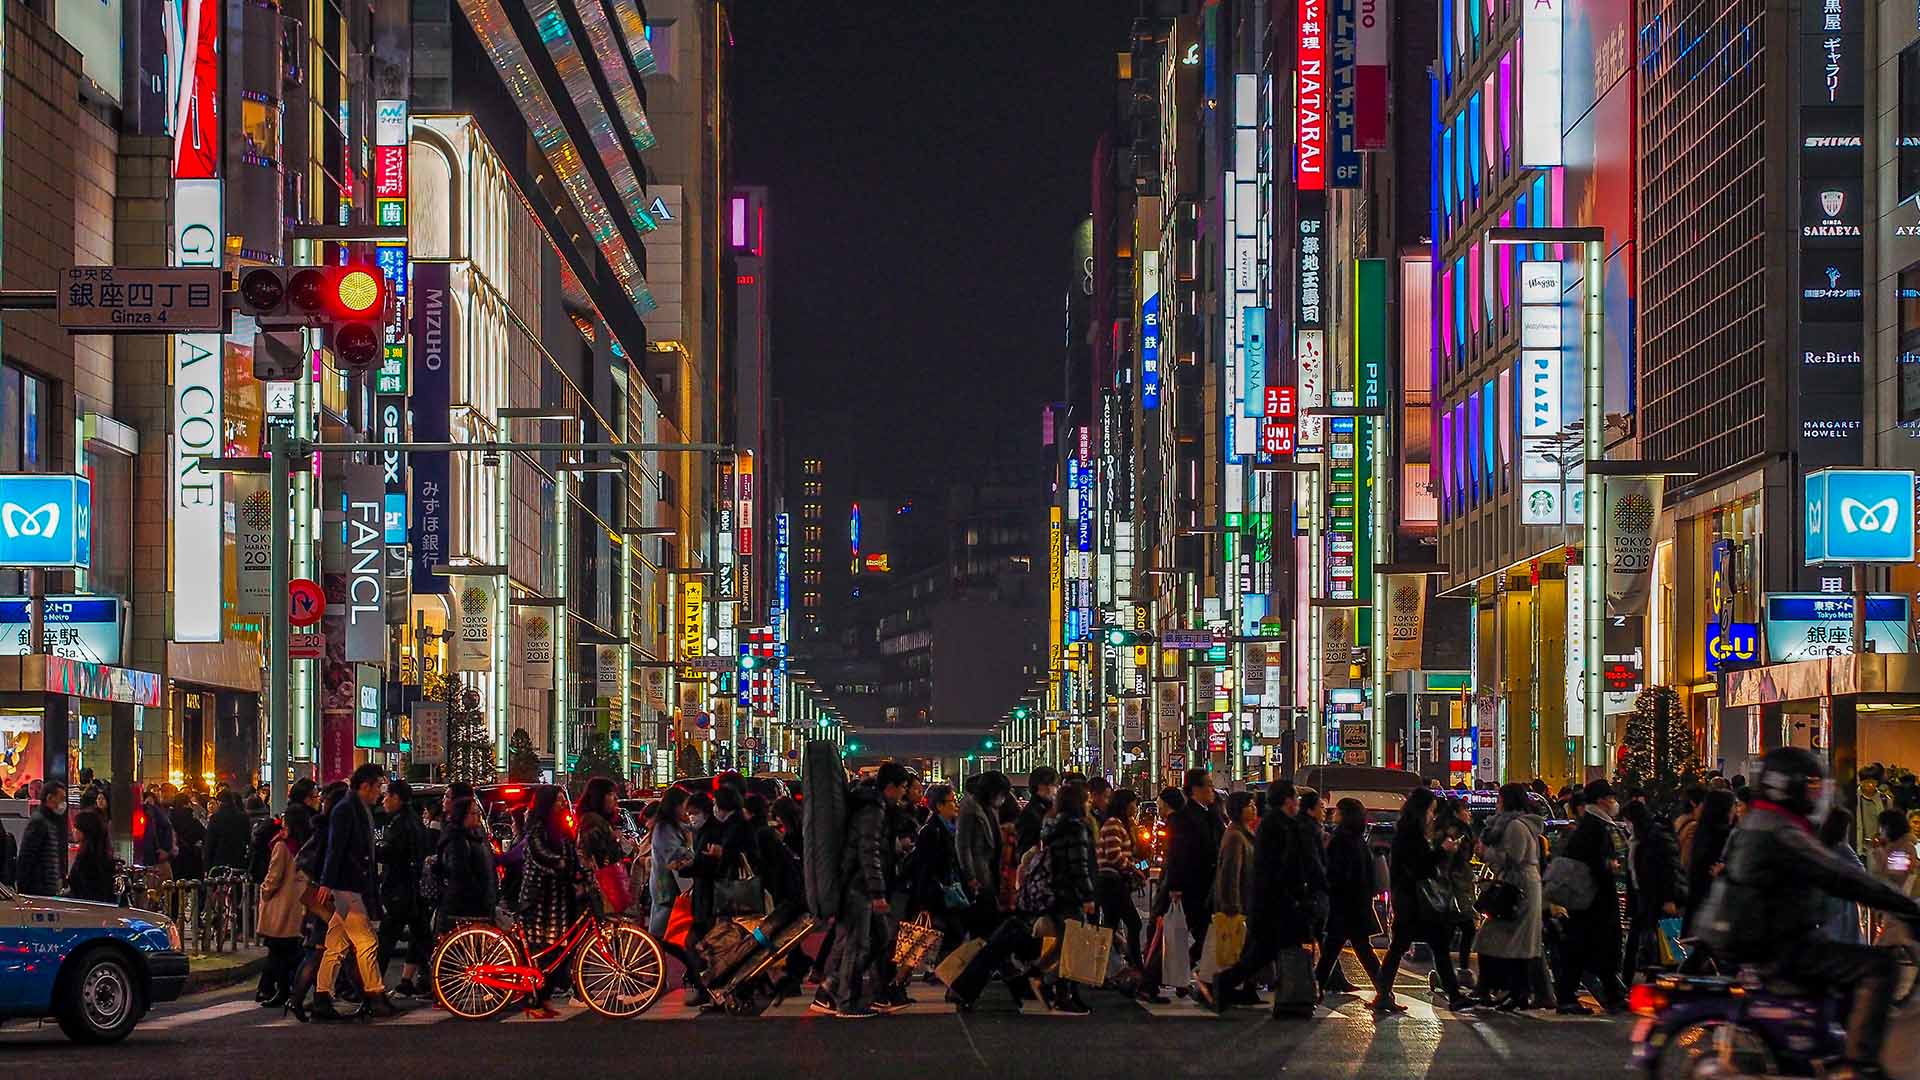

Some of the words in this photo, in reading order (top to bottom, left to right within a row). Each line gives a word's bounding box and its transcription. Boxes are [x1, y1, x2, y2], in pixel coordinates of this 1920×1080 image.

[1301, 60, 1320, 173] NATARAJ
[1804, 137, 1863, 147] SHIMA
[1337, 165, 1358, 178] 6F
[382, 203, 401, 226] 歯
[1300, 221, 1320, 233] 6F
[1803, 226, 1861, 236] SAKAEYA
[69, 269, 113, 280] 中央区
[69, 283, 211, 308] 銀座四丁目
[111, 309, 151, 323] Ginza
[158, 310, 167, 322] 4
[427, 289, 443, 371] MIZUHO
[1144, 313, 1157, 395] 名鉄観光
[1804, 352, 1861, 363] Re:Birth
[1250, 340, 1262, 390] DIANA
[1534, 359, 1549, 428] PLAZA
[1803, 421, 1861, 429] MARGARET
[1267, 427, 1289, 438] UNI
[1803, 430, 1848, 438] HOWELL
[180, 386, 214, 509] CORE
[384, 405, 398, 484] GEOX
[1268, 439, 1291, 452] QLO
[421, 481, 440, 568] みずほ銀行
[1614, 537, 1653, 546] TOKYO
[351, 502, 380, 625] FANCL
[1614, 555, 1650, 567] 2018
[1814, 602, 1853, 610] 東京メト
[1817, 612, 1837, 620] Tokyo
[462, 629, 487, 638] 2018
[1392, 628, 1418, 636] 2018
[56, 648, 79, 658] Sta.
[527, 652, 550, 660] 2018
[1326, 652, 1347, 660] 2018
